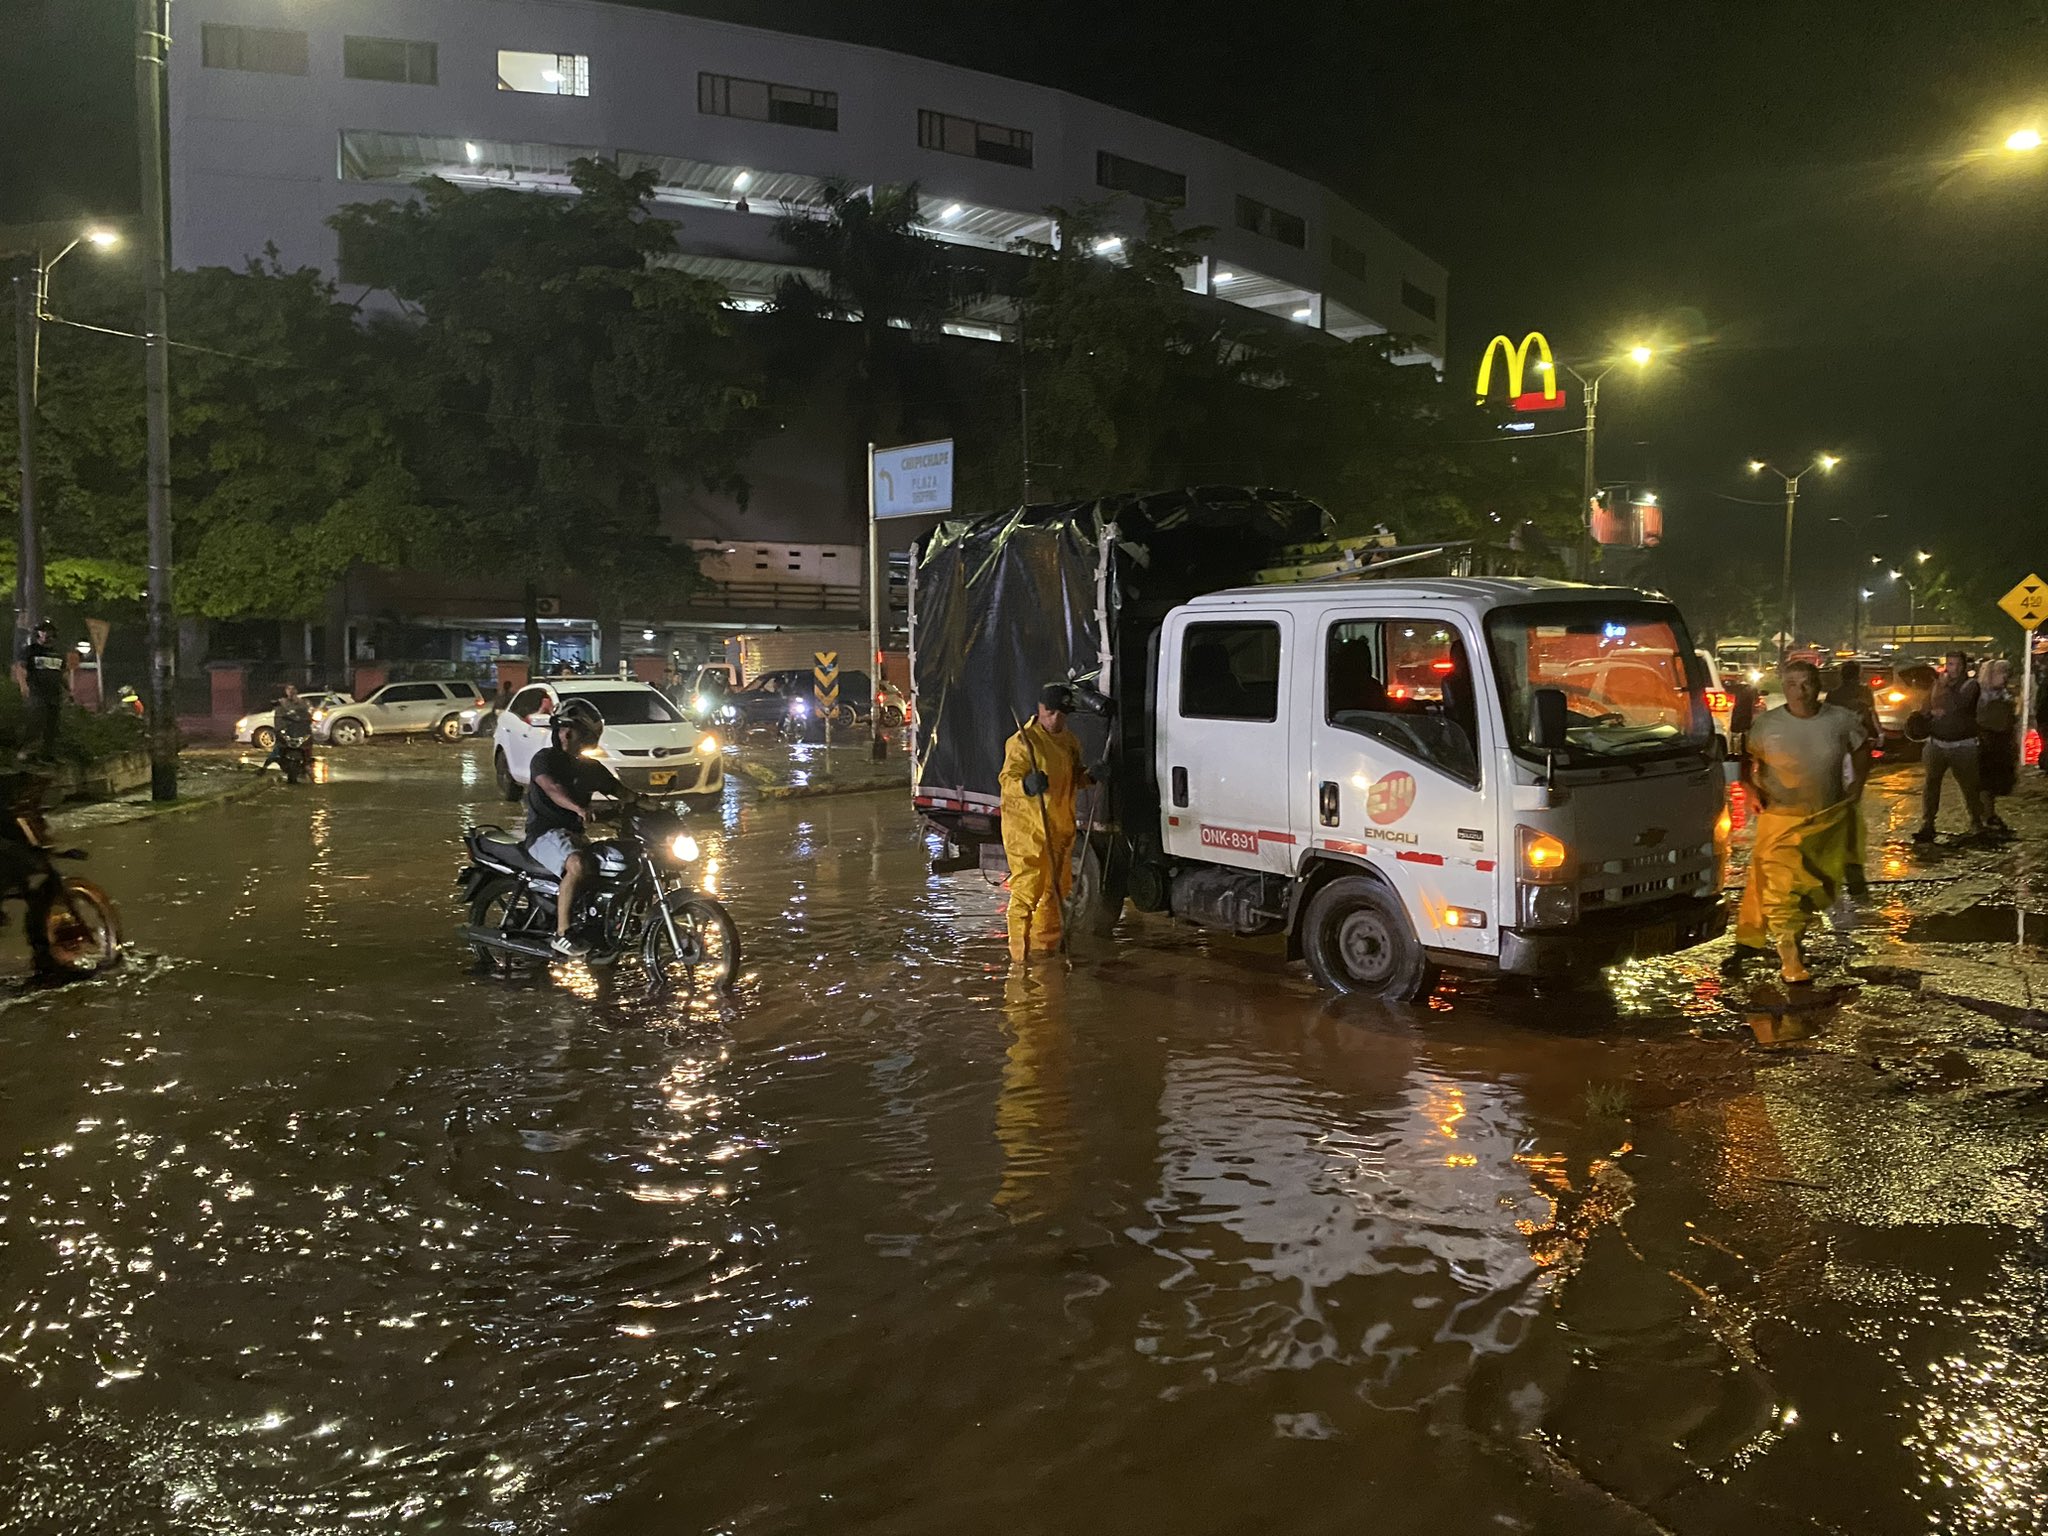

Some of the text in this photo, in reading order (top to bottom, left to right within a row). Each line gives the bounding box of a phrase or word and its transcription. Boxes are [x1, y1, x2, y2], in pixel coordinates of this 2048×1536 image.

[902, 452, 948, 471] CHIPICHAPE
[912, 475, 937, 489] PLAZA
[1202, 828, 1255, 850] ONK-891
[1364, 827, 1418, 845] EMCALI
